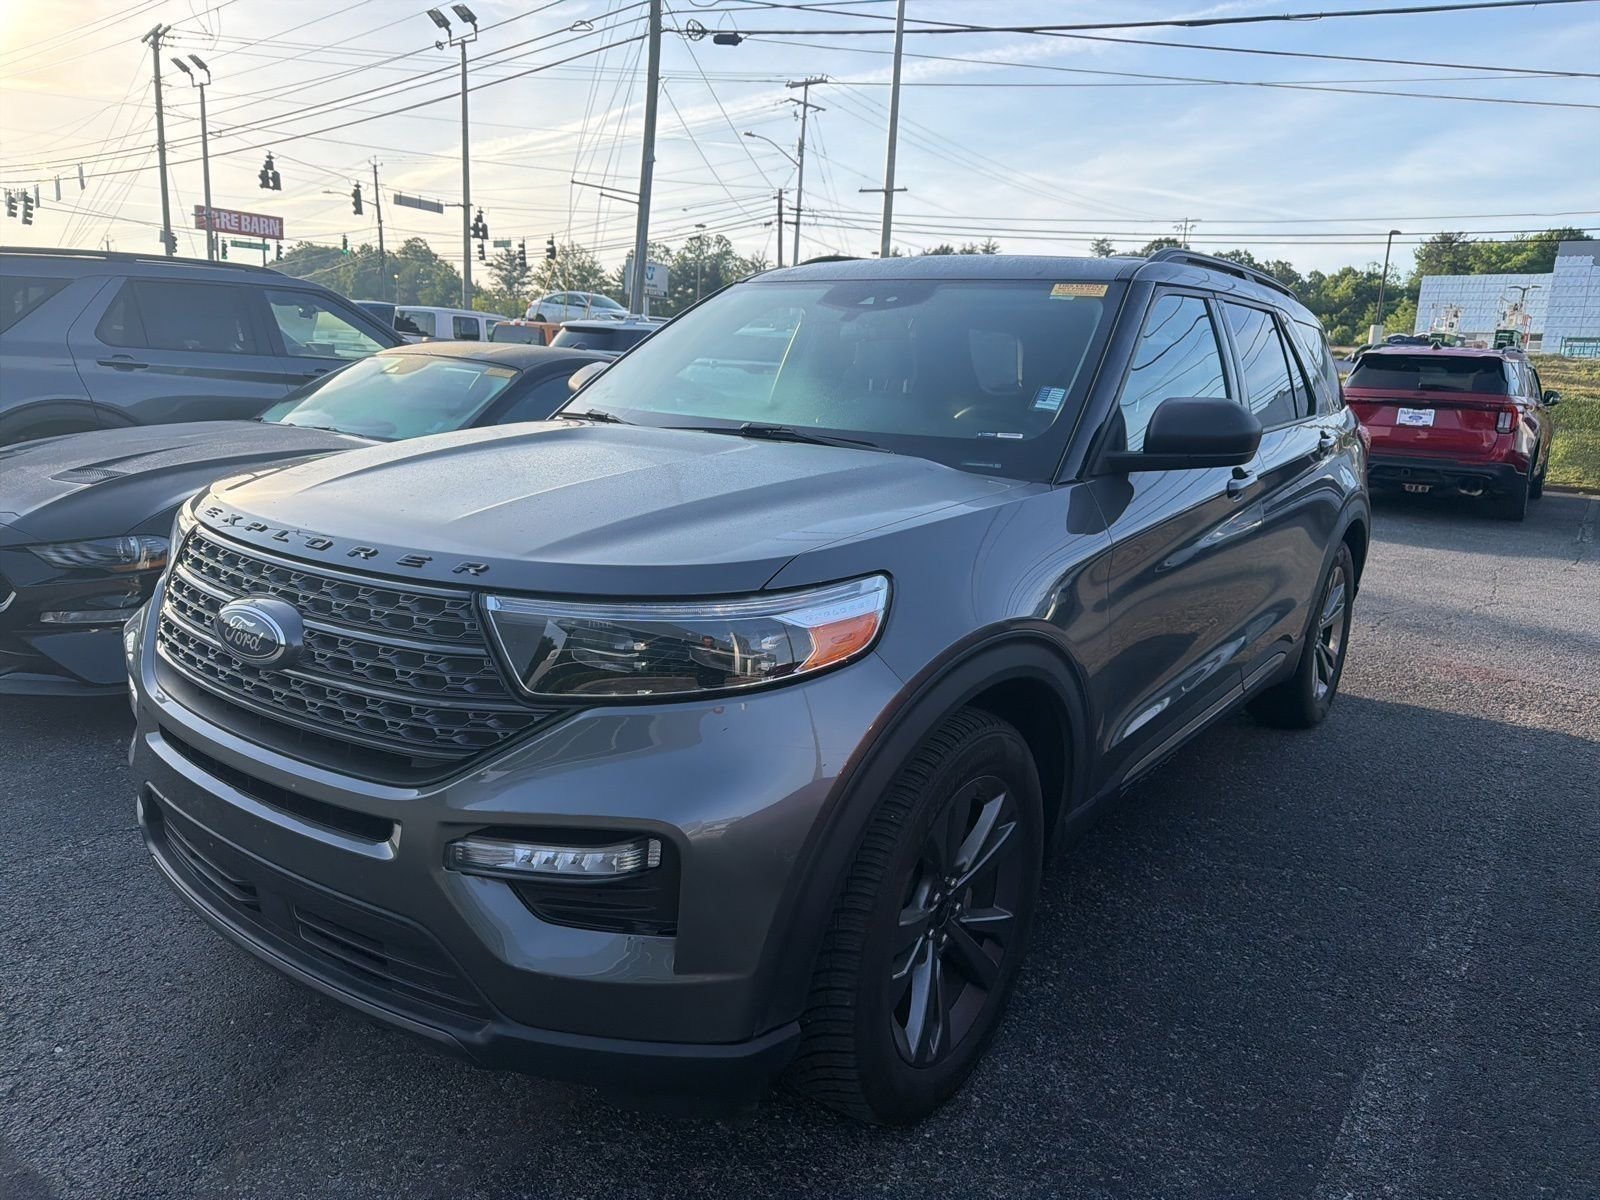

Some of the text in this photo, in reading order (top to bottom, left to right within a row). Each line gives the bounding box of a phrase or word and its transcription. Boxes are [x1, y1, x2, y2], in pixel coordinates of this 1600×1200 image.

[241, 215, 280, 236] BARN
[204, 505, 491, 577] EXPLORER
[224, 614, 265, 652] Ford
